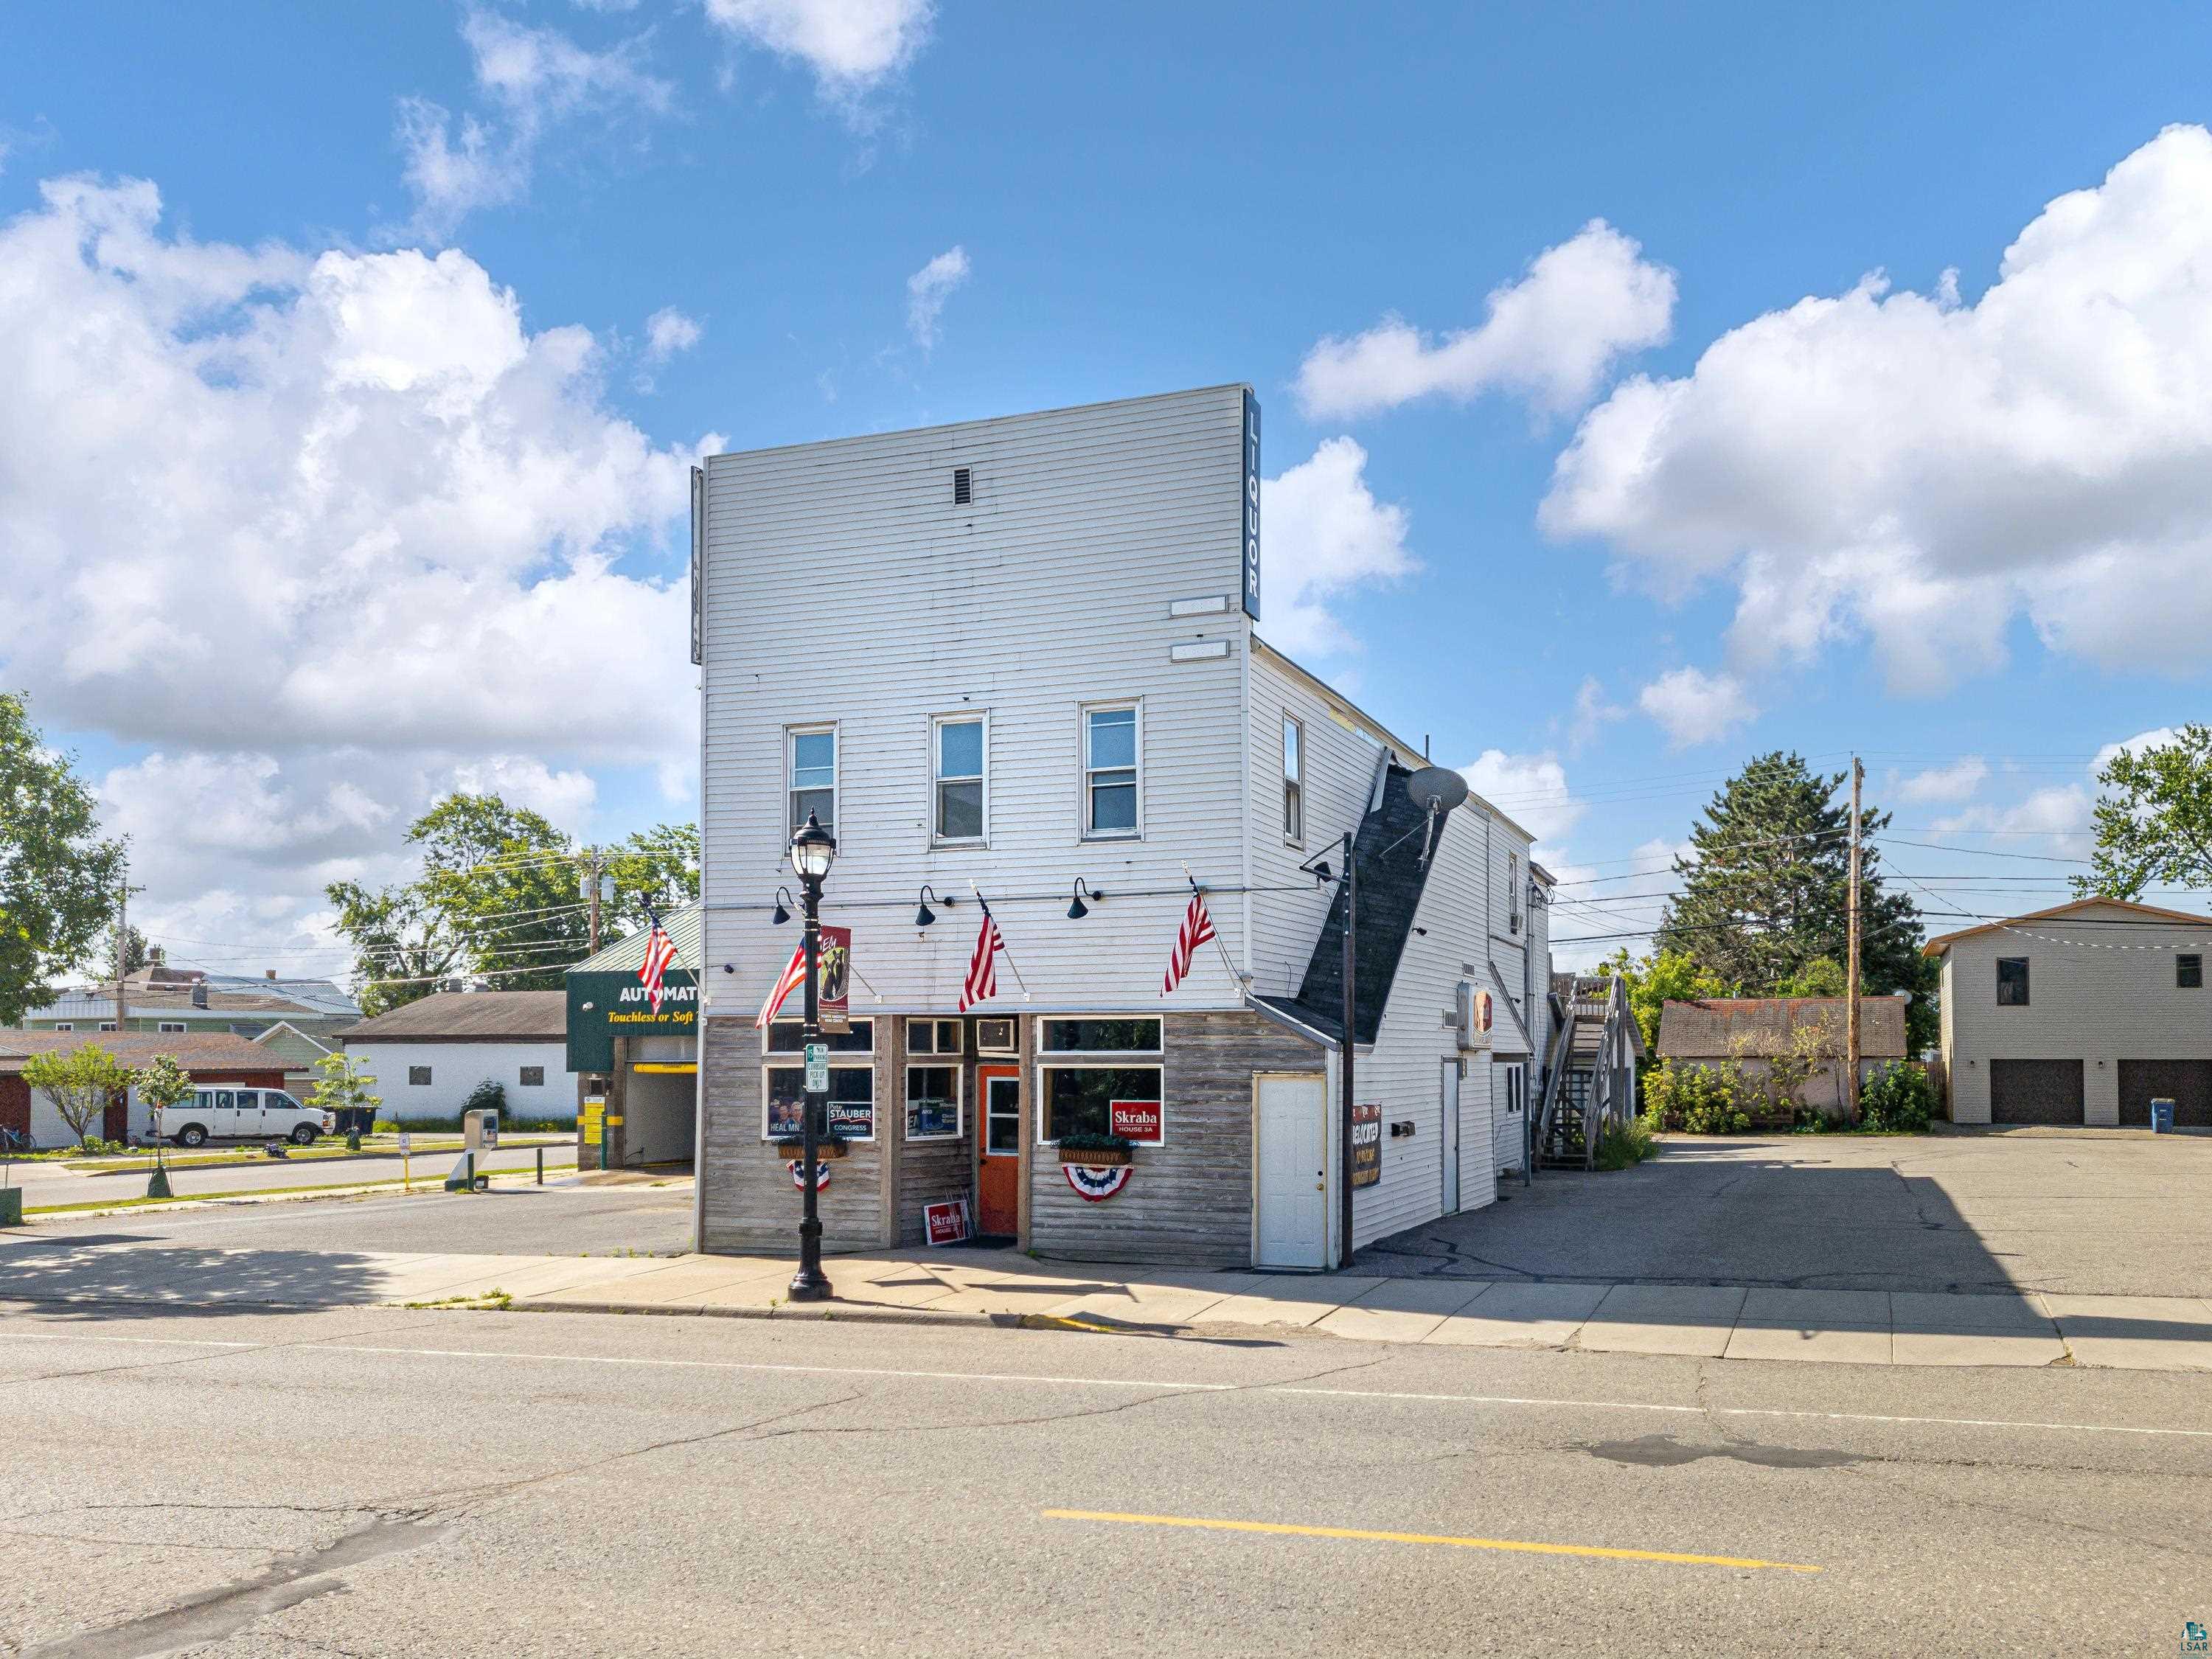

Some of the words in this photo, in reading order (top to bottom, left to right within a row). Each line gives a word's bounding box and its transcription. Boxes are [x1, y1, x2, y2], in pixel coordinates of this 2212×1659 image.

[1248, 411, 1258, 599] LIQUOR
[822, 935, 837, 951] Ely
[608, 1011, 655, 1023] Touchless
[658, 1014, 669, 1023] or
[672, 1011, 694, 1025] Soft
[830, 1109, 872, 1119] STAUBER
[1115, 1110, 1157, 1124] Skraba
[771, 1123, 787, 1132] HEAL
[788, 1123, 799, 1132] MN
